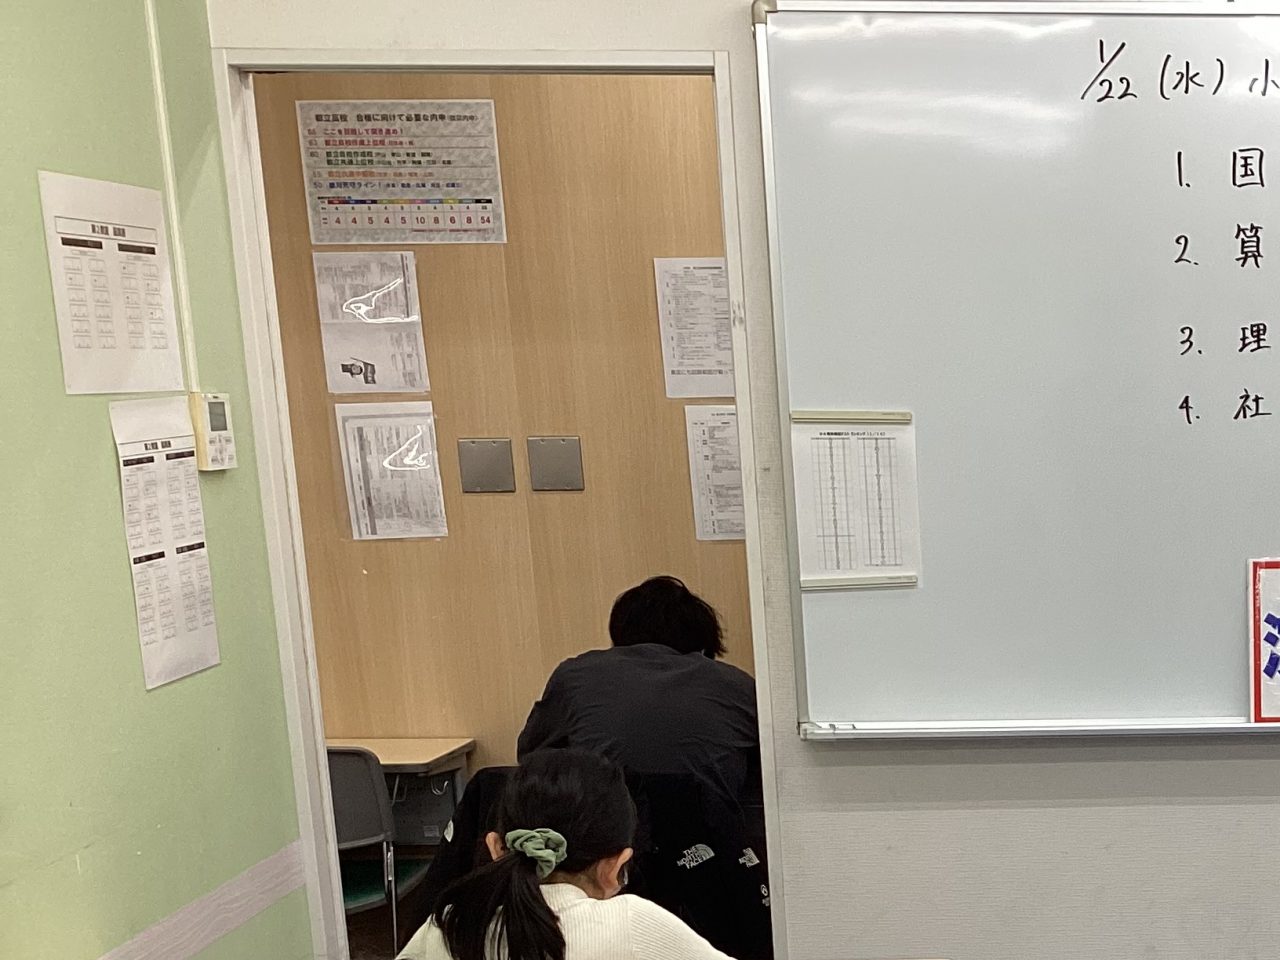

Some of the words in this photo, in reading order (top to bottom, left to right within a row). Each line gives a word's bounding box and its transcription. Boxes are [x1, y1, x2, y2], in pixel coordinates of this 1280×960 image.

[1159, 53, 1225, 101] (水)
[1176, 150, 1191, 188] 1.
[1173, 234, 1200, 266] 2.
[1179, 326, 1203, 356] 3.
[1178, 395, 1201, 425] 4.
